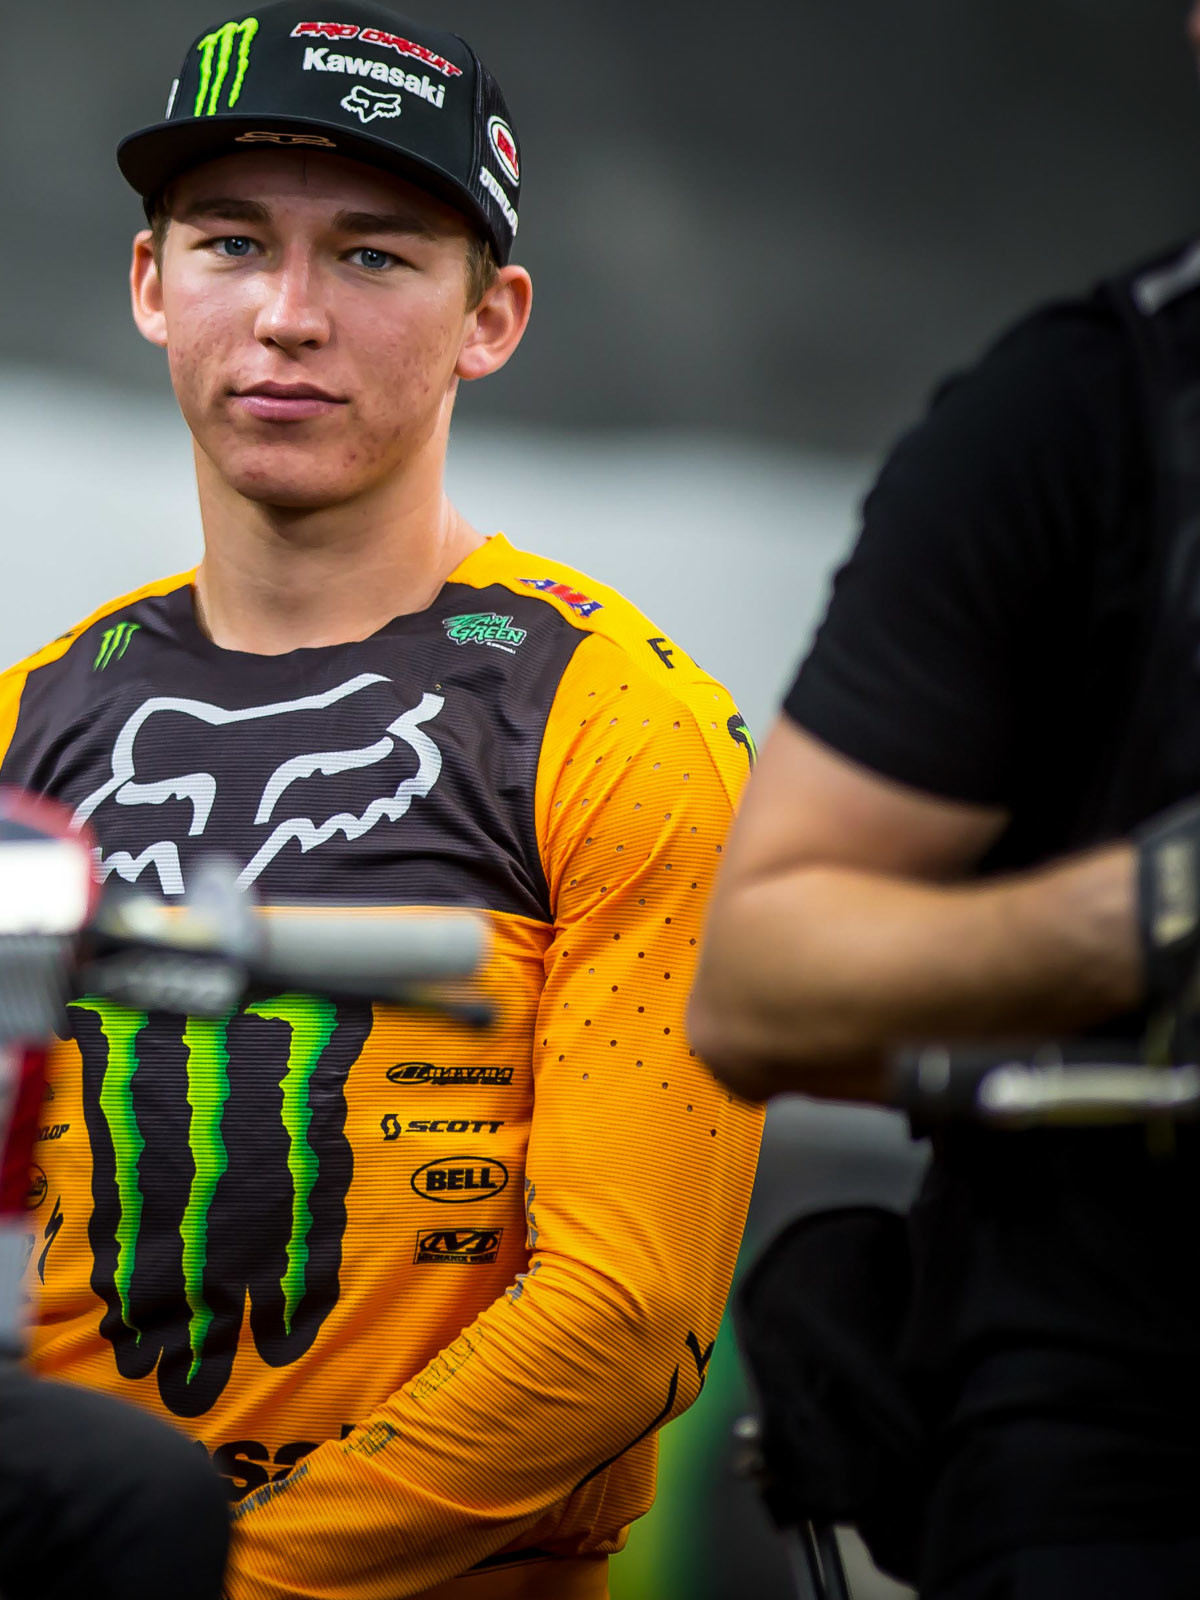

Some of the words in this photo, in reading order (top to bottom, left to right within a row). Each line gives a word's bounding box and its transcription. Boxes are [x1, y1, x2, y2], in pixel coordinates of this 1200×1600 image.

[290, 21, 361, 41] PRO
[358, 27, 463, 78] CIRCUIT
[302, 47, 446, 109] Kawasaki
[443, 612, 513, 630] TEAM
[448, 624, 527, 646] GREEN
[405, 1120, 505, 1134] SCOTT
[426, 1167, 498, 1192] BELL
